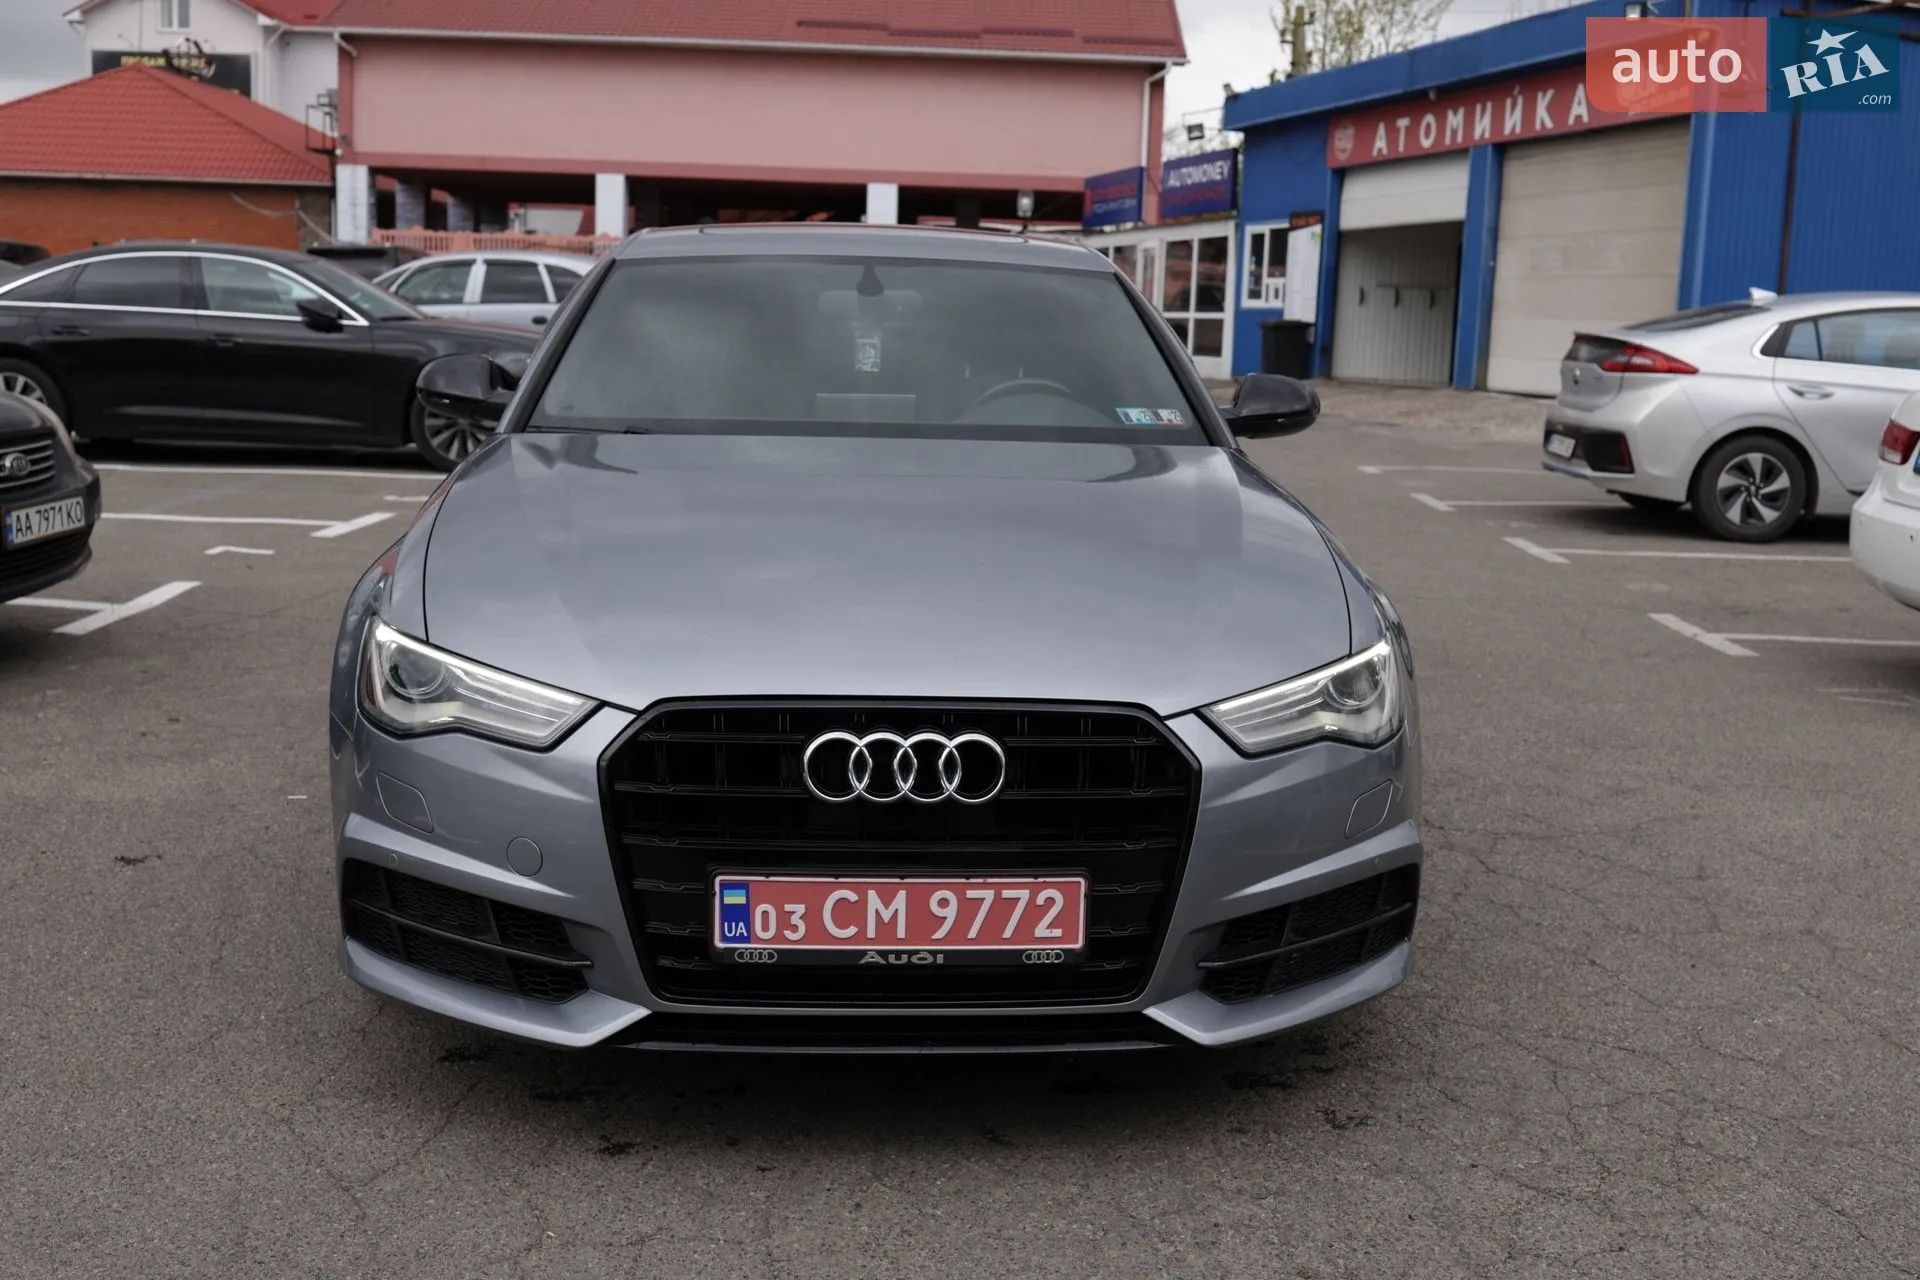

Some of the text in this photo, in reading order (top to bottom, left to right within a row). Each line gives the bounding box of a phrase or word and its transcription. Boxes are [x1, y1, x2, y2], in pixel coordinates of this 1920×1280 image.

[1371, 83, 1590, 157] АТОМИЙКА
[1167, 160, 1231, 188] AUTOMONEY
[15, 499, 83, 539] AA 7971 KO
[724, 921, 748, 937] UA
[754, 889, 1064, 942] 03 CM 9772
[858, 951, 944, 965] Audi
